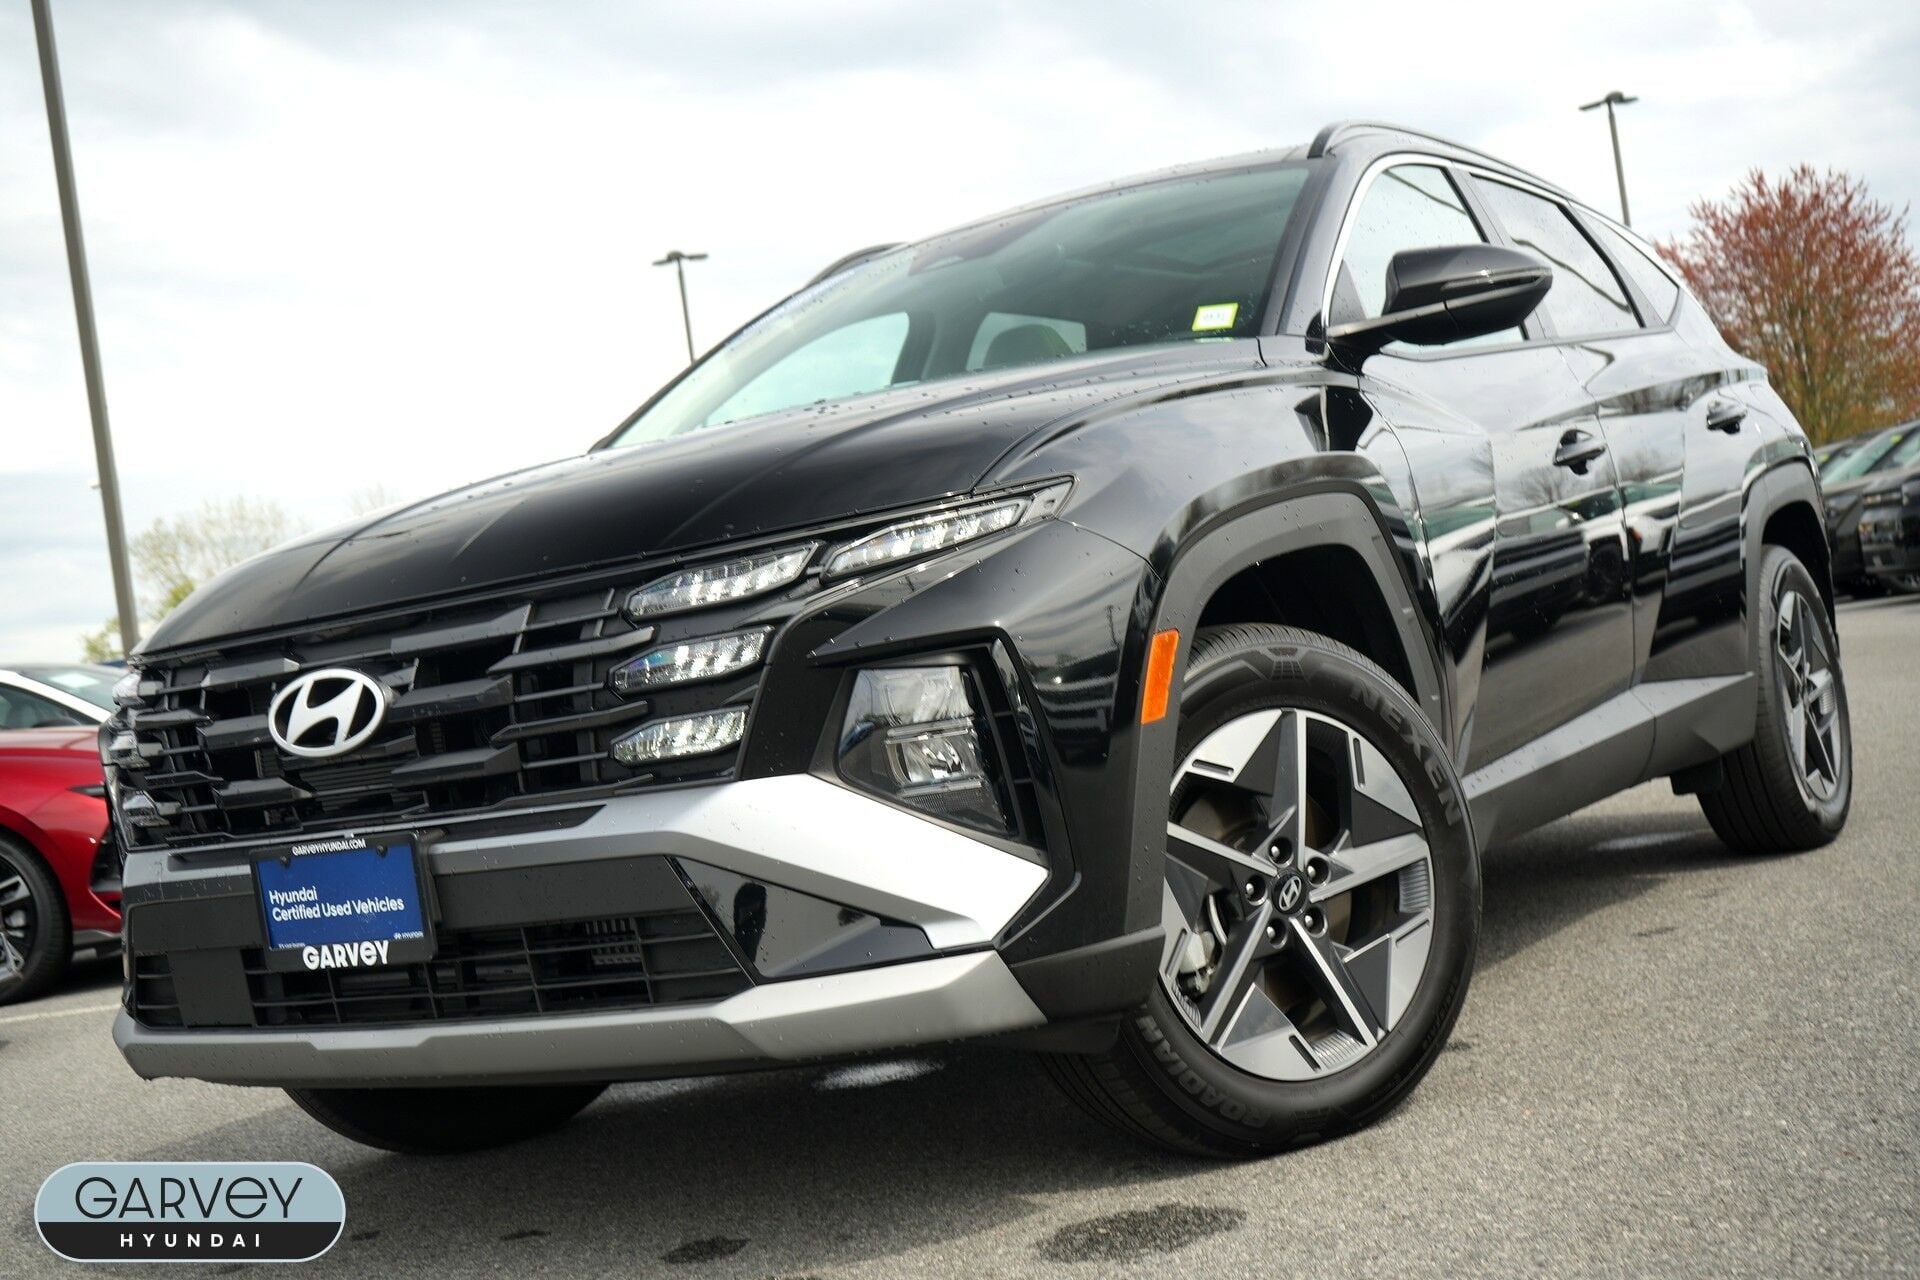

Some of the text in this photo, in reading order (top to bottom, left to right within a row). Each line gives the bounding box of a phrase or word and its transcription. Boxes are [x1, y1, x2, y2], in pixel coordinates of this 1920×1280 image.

[1350, 681, 1462, 826] NEXEN
[269, 886, 318, 906] Hyundai
[272, 896, 405, 922] Certified Used Vehicles
[1135, 1014, 1270, 1128] ROADIAN
